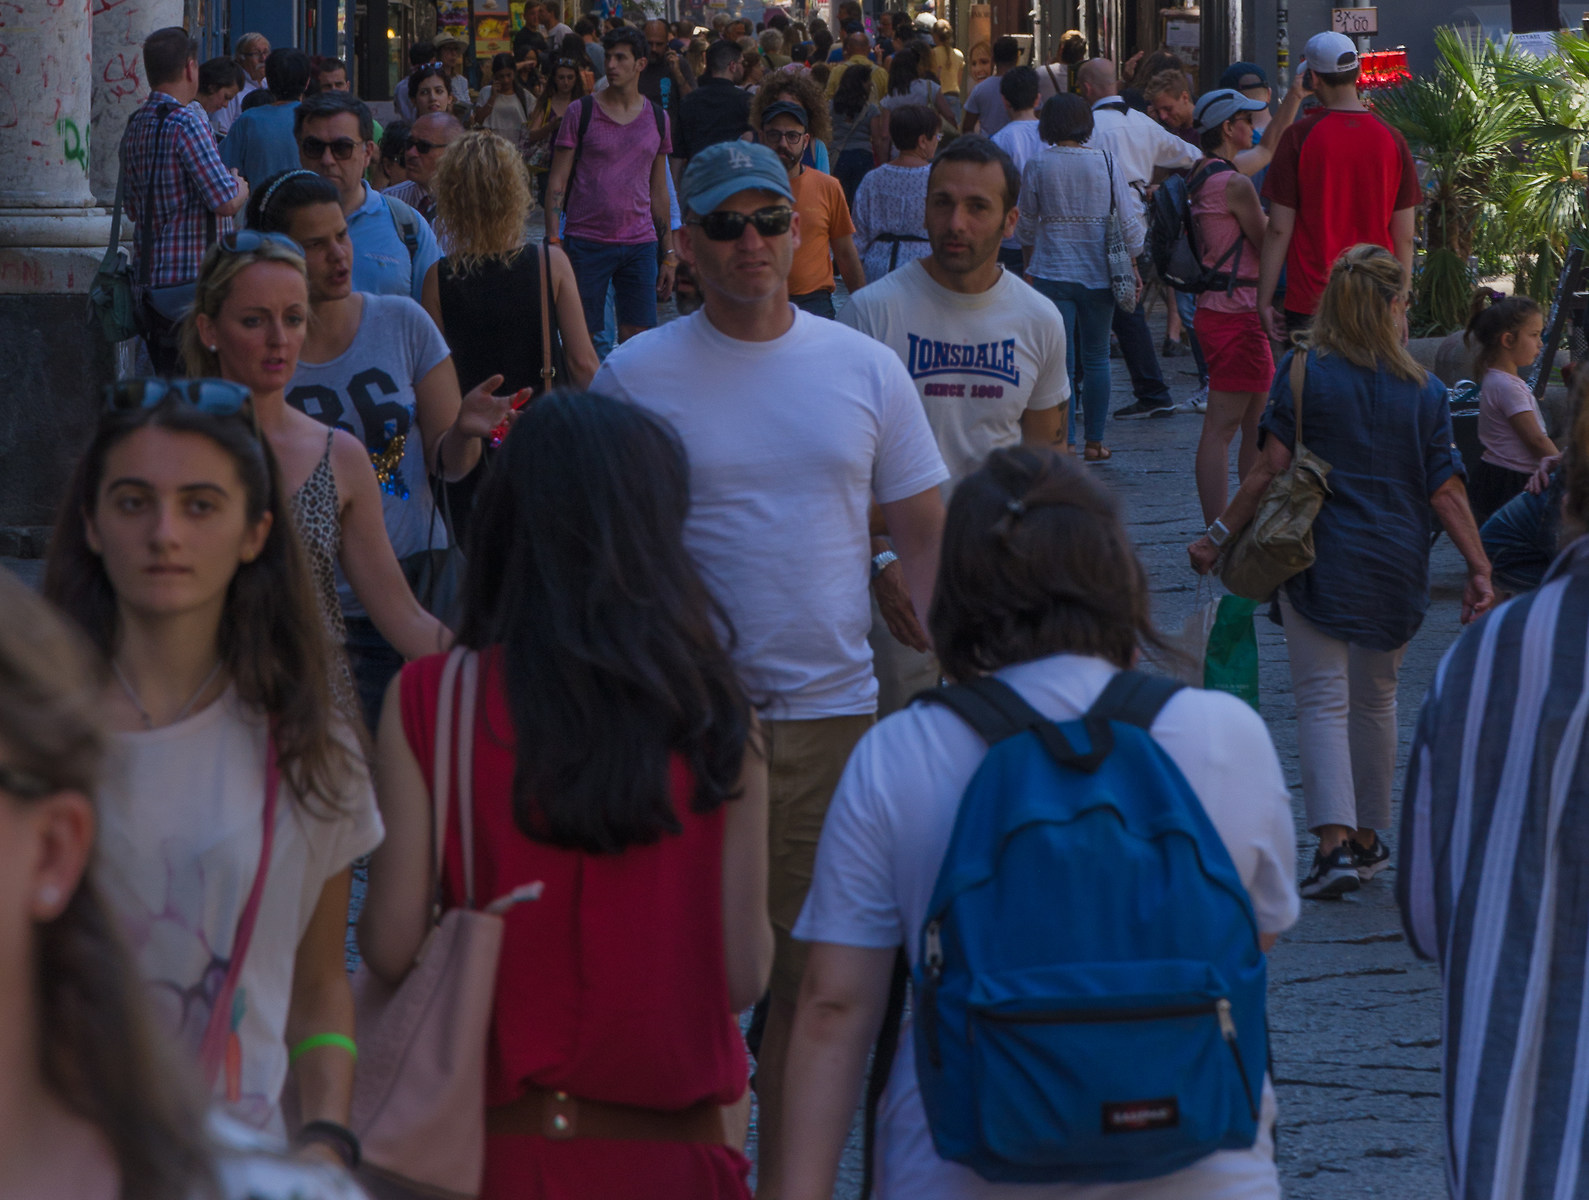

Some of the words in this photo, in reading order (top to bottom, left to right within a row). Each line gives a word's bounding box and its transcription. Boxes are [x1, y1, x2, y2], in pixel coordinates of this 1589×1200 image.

[728, 147, 753, 169] LA
[908, 332, 1019, 387] LONSDALE
[924, 383, 965, 397] SINCE
